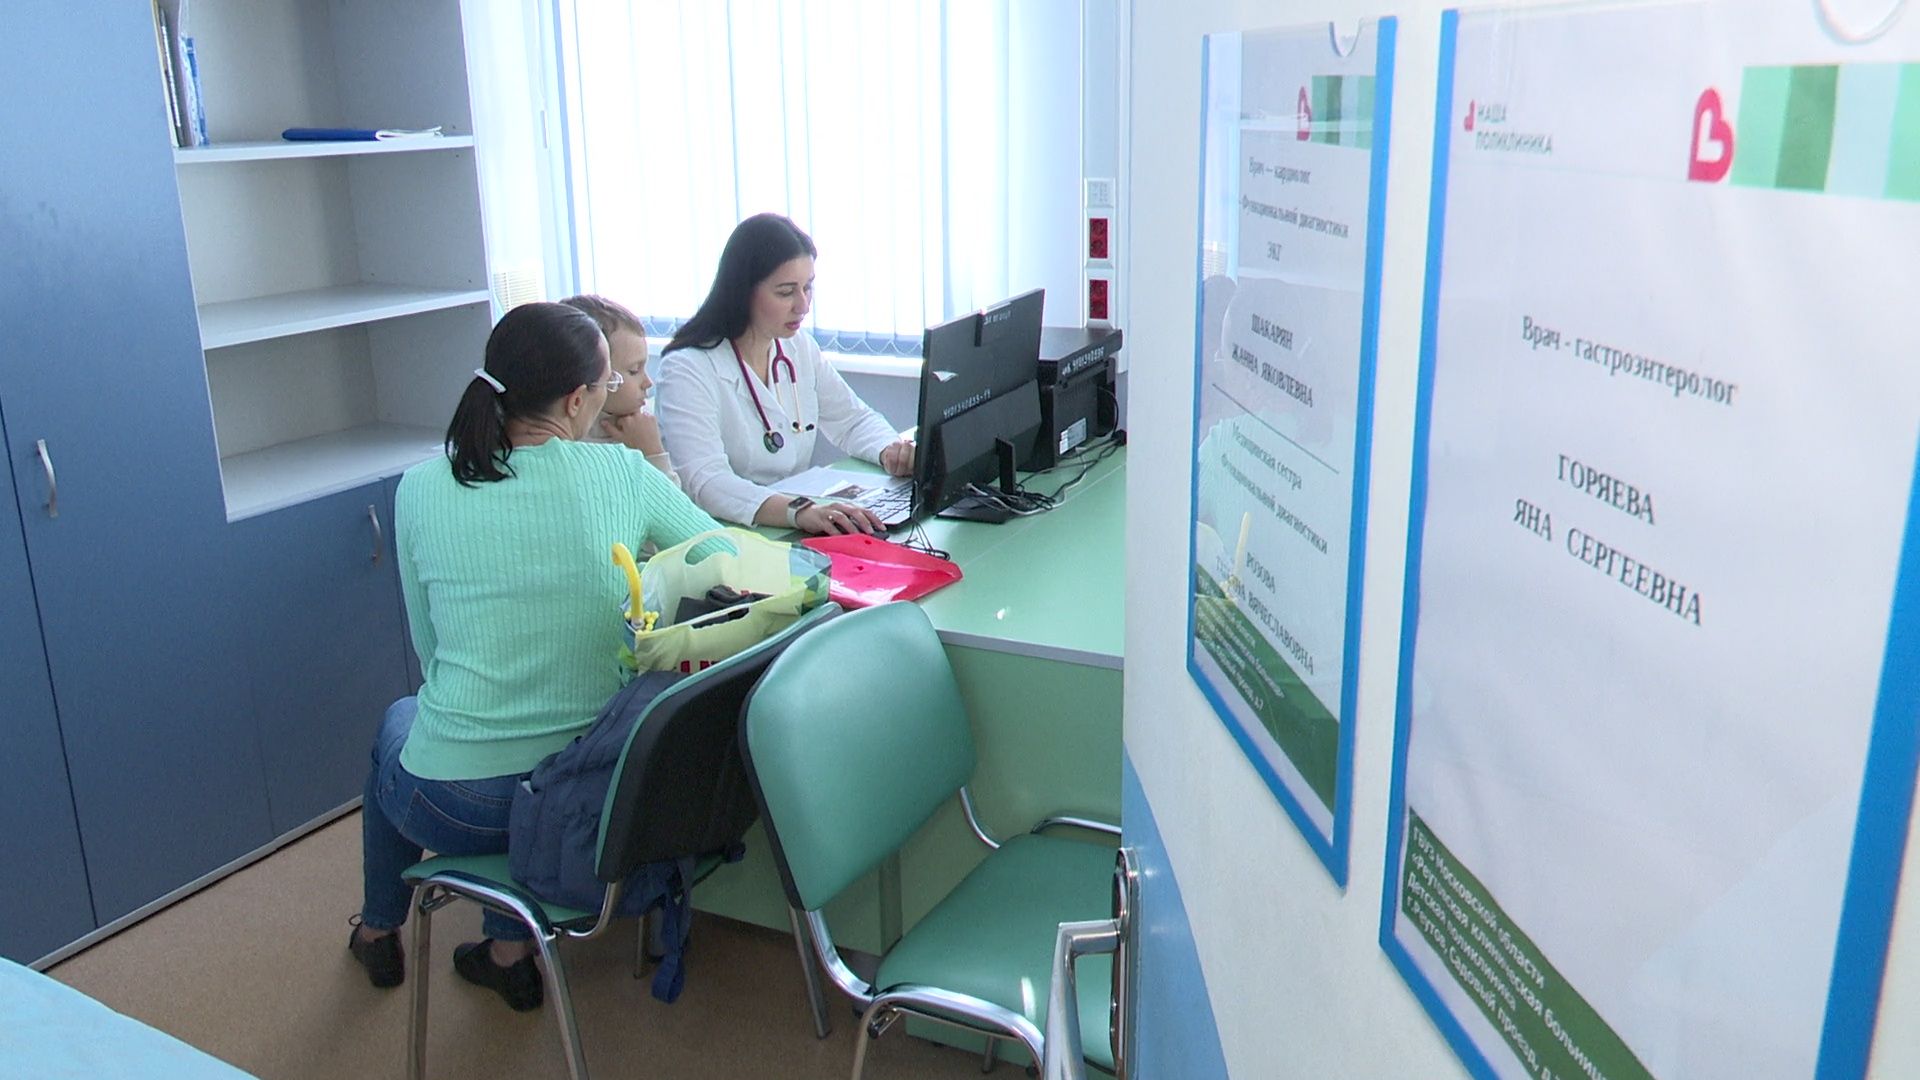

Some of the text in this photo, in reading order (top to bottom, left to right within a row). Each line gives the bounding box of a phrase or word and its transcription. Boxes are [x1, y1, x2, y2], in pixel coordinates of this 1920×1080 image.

[1475, 130, 1552, 154] ПОЛИКЛИНИКА
[1476, 103, 1507, 123] НАША
[1251, 313, 1294, 350] ШАКАРЯН
[1521, 315, 1561, 353] Врач
[1574, 337, 1739, 406] гастроэнтеролог
[1231, 342, 1314, 409] ЖАННА ЯКОВЛЕВНА
[1276, 461, 1303, 491] сестра
[1556, 453, 1656, 525] ГОРЯЕВА
[1275, 502, 1329, 555] диагностики
[1513, 497, 1703, 627] ЯНА СЕРГЕЕВНА
[1247, 590, 1315, 676] ВЯЧЕСЛАВОВНА
[1407, 870, 1517, 1012] Детская поликлиника
[1411, 826, 1546, 990] ГБУЗ Московской области
[1449, 946, 1497, 1012] Садовый
[1470, 921, 1543, 1018] клиническая
[1543, 1008, 1608, 1080] больниц
